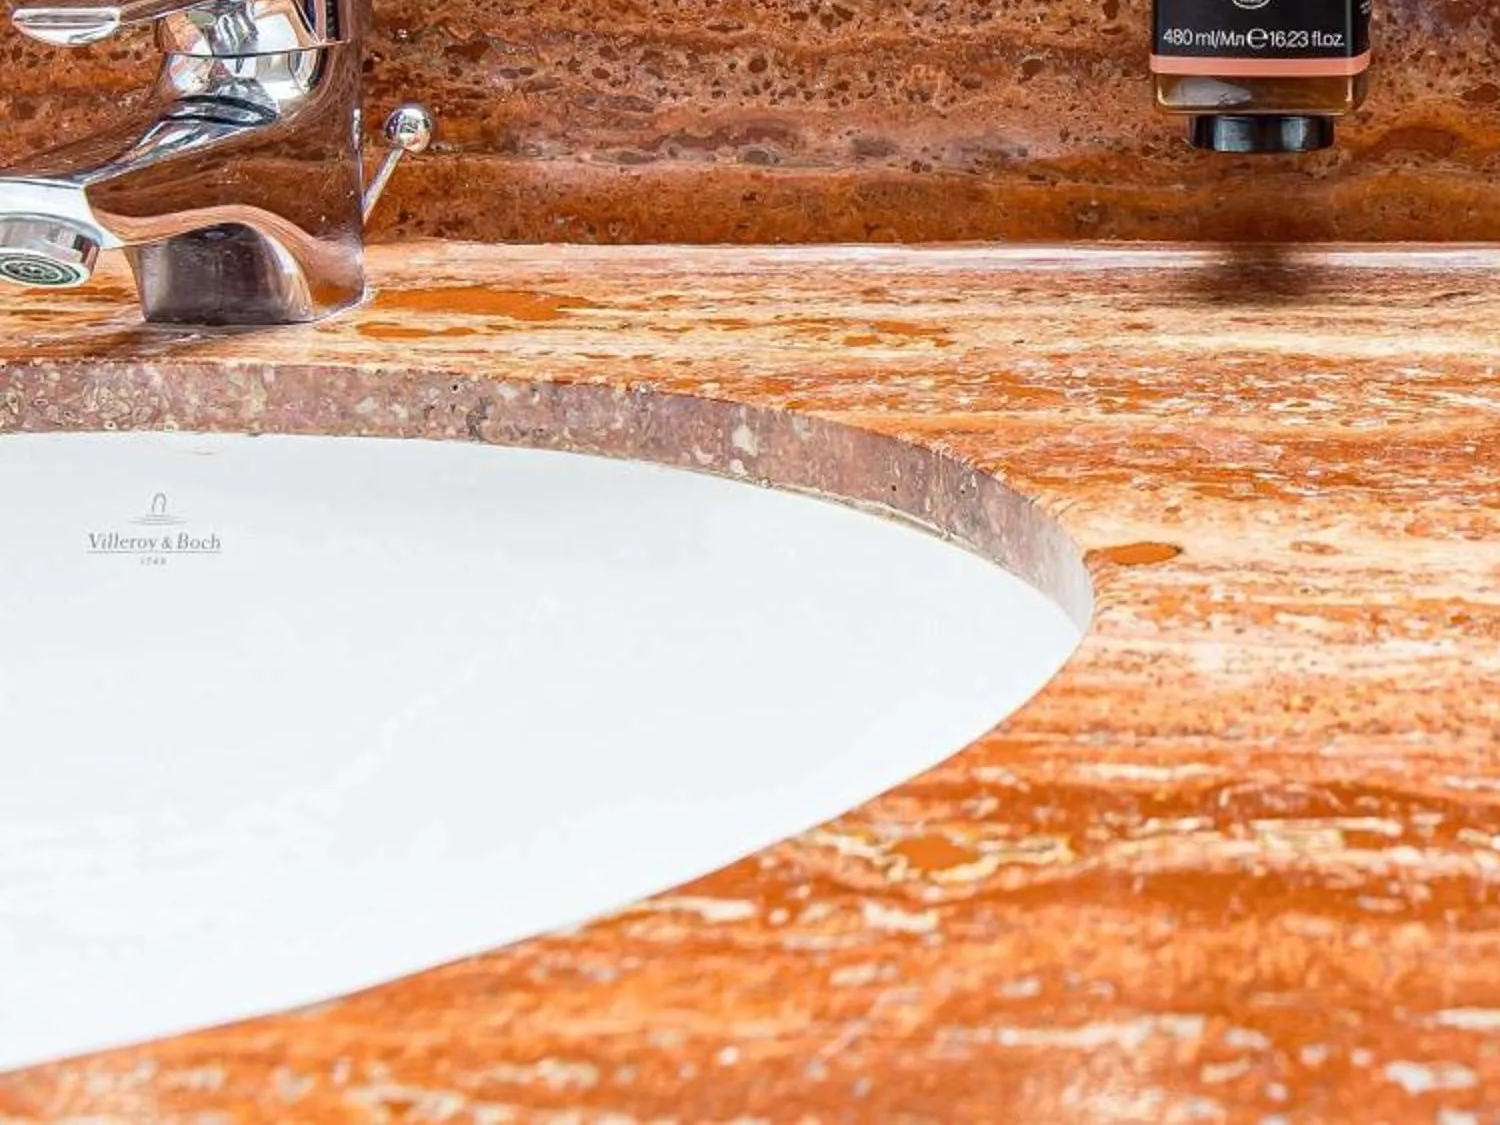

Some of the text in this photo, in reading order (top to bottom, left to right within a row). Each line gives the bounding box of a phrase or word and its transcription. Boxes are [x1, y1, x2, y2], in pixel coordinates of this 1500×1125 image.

[1163, 28, 1193, 45] 480
[88, 531, 221, 551] Villeroy & Boch
